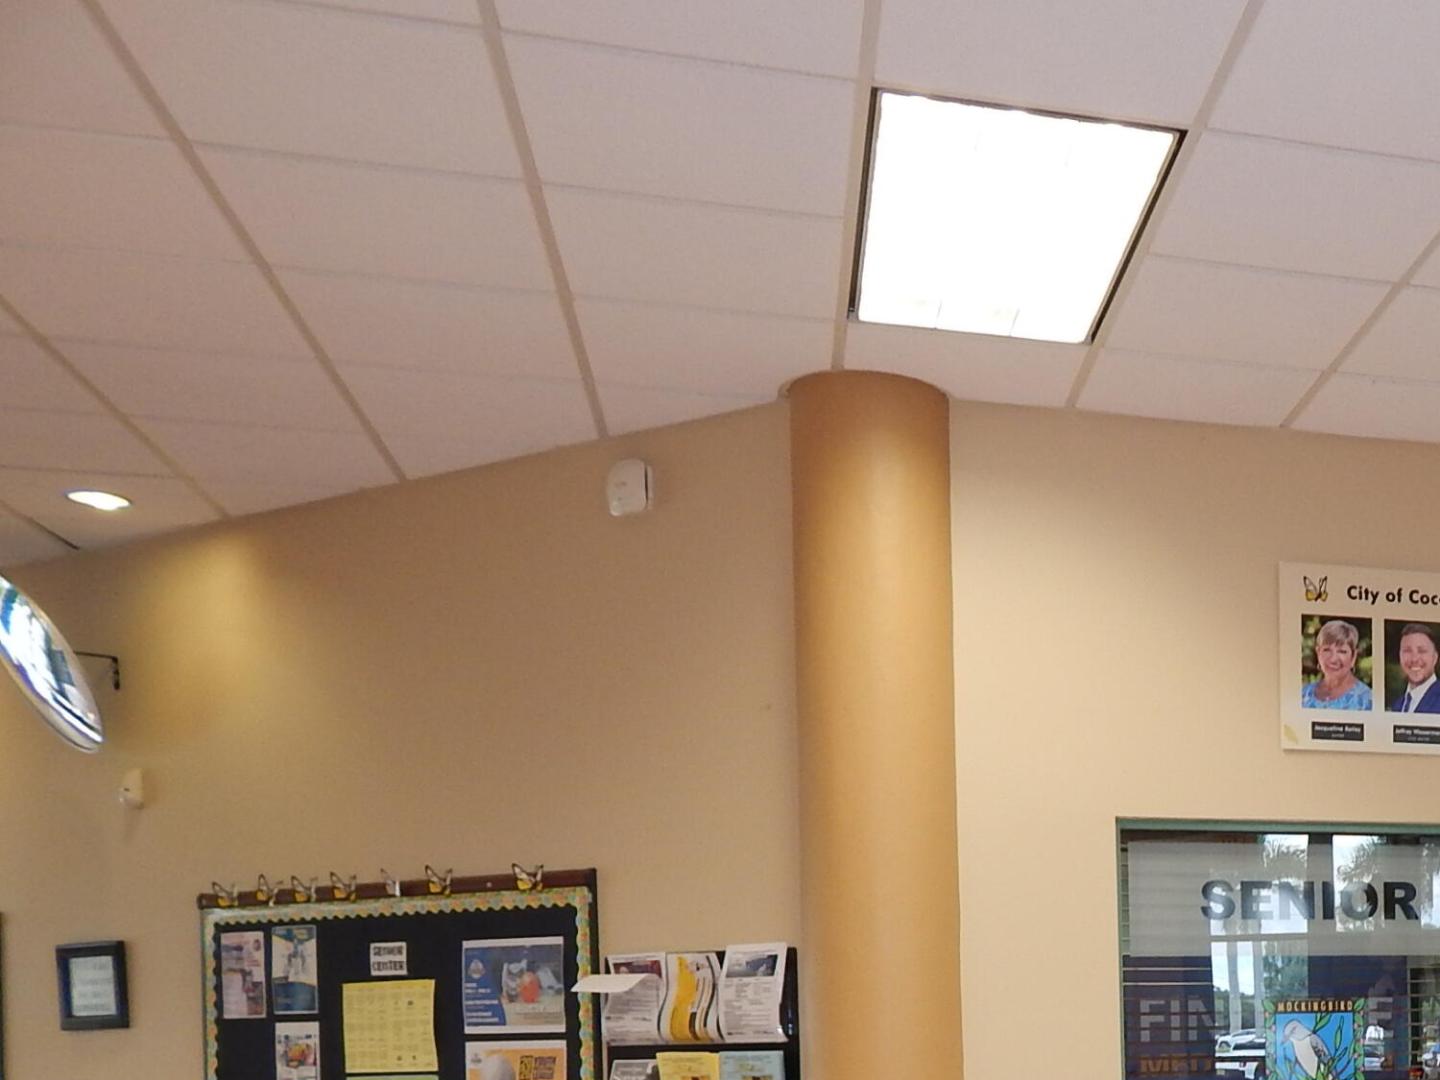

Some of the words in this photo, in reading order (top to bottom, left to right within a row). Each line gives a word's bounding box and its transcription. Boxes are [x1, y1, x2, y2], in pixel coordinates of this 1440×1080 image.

[1346, 585, 1380, 605] City
[1385, 587, 1403, 604] of
[1200, 879, 1420, 921] SENIOR
[372, 960, 405, 972] CENTER
[1276, 1000, 1353, 1012] MOCKINGBIRD
